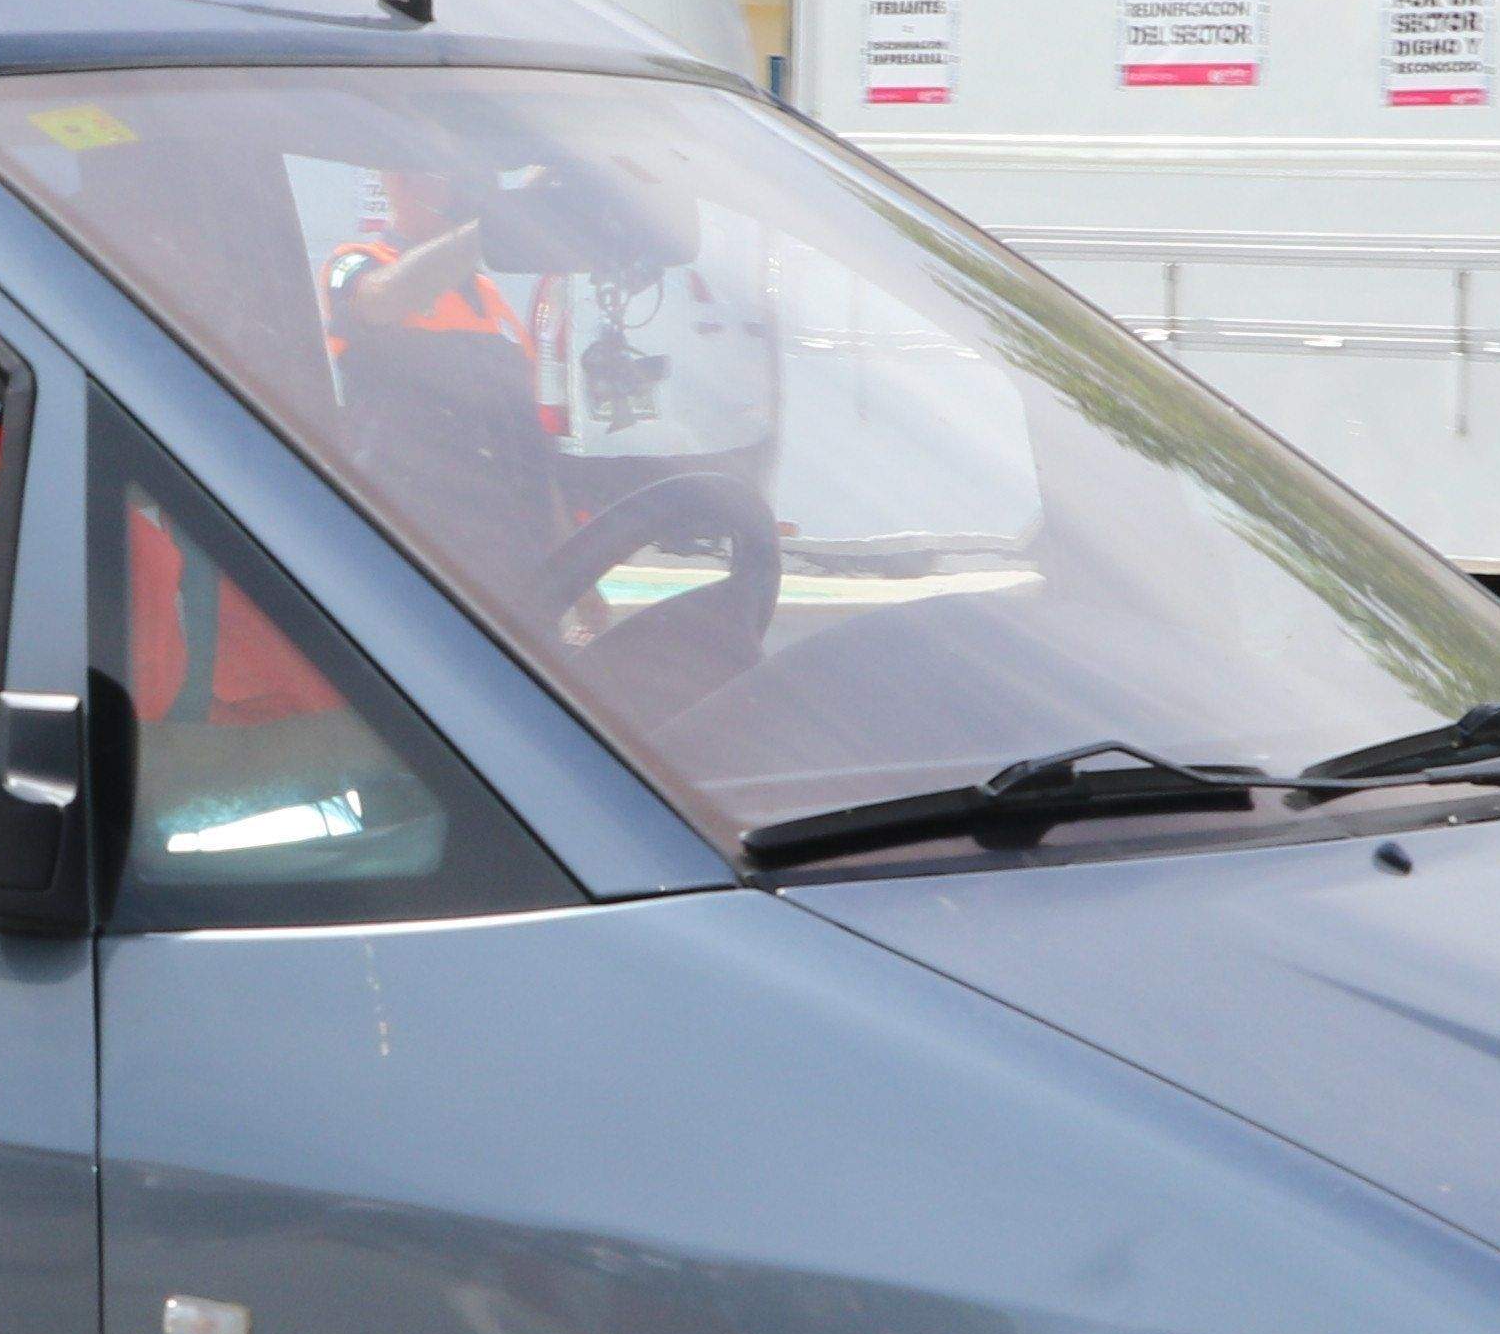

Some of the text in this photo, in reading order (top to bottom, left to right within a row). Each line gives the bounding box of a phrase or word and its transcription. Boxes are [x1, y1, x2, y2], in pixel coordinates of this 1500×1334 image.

[1391, 11, 1484, 33] SECTOR
[1128, 23, 1253, 45] DEL SECTOR
[1393, 37, 1482, 56] DIGNO Y
